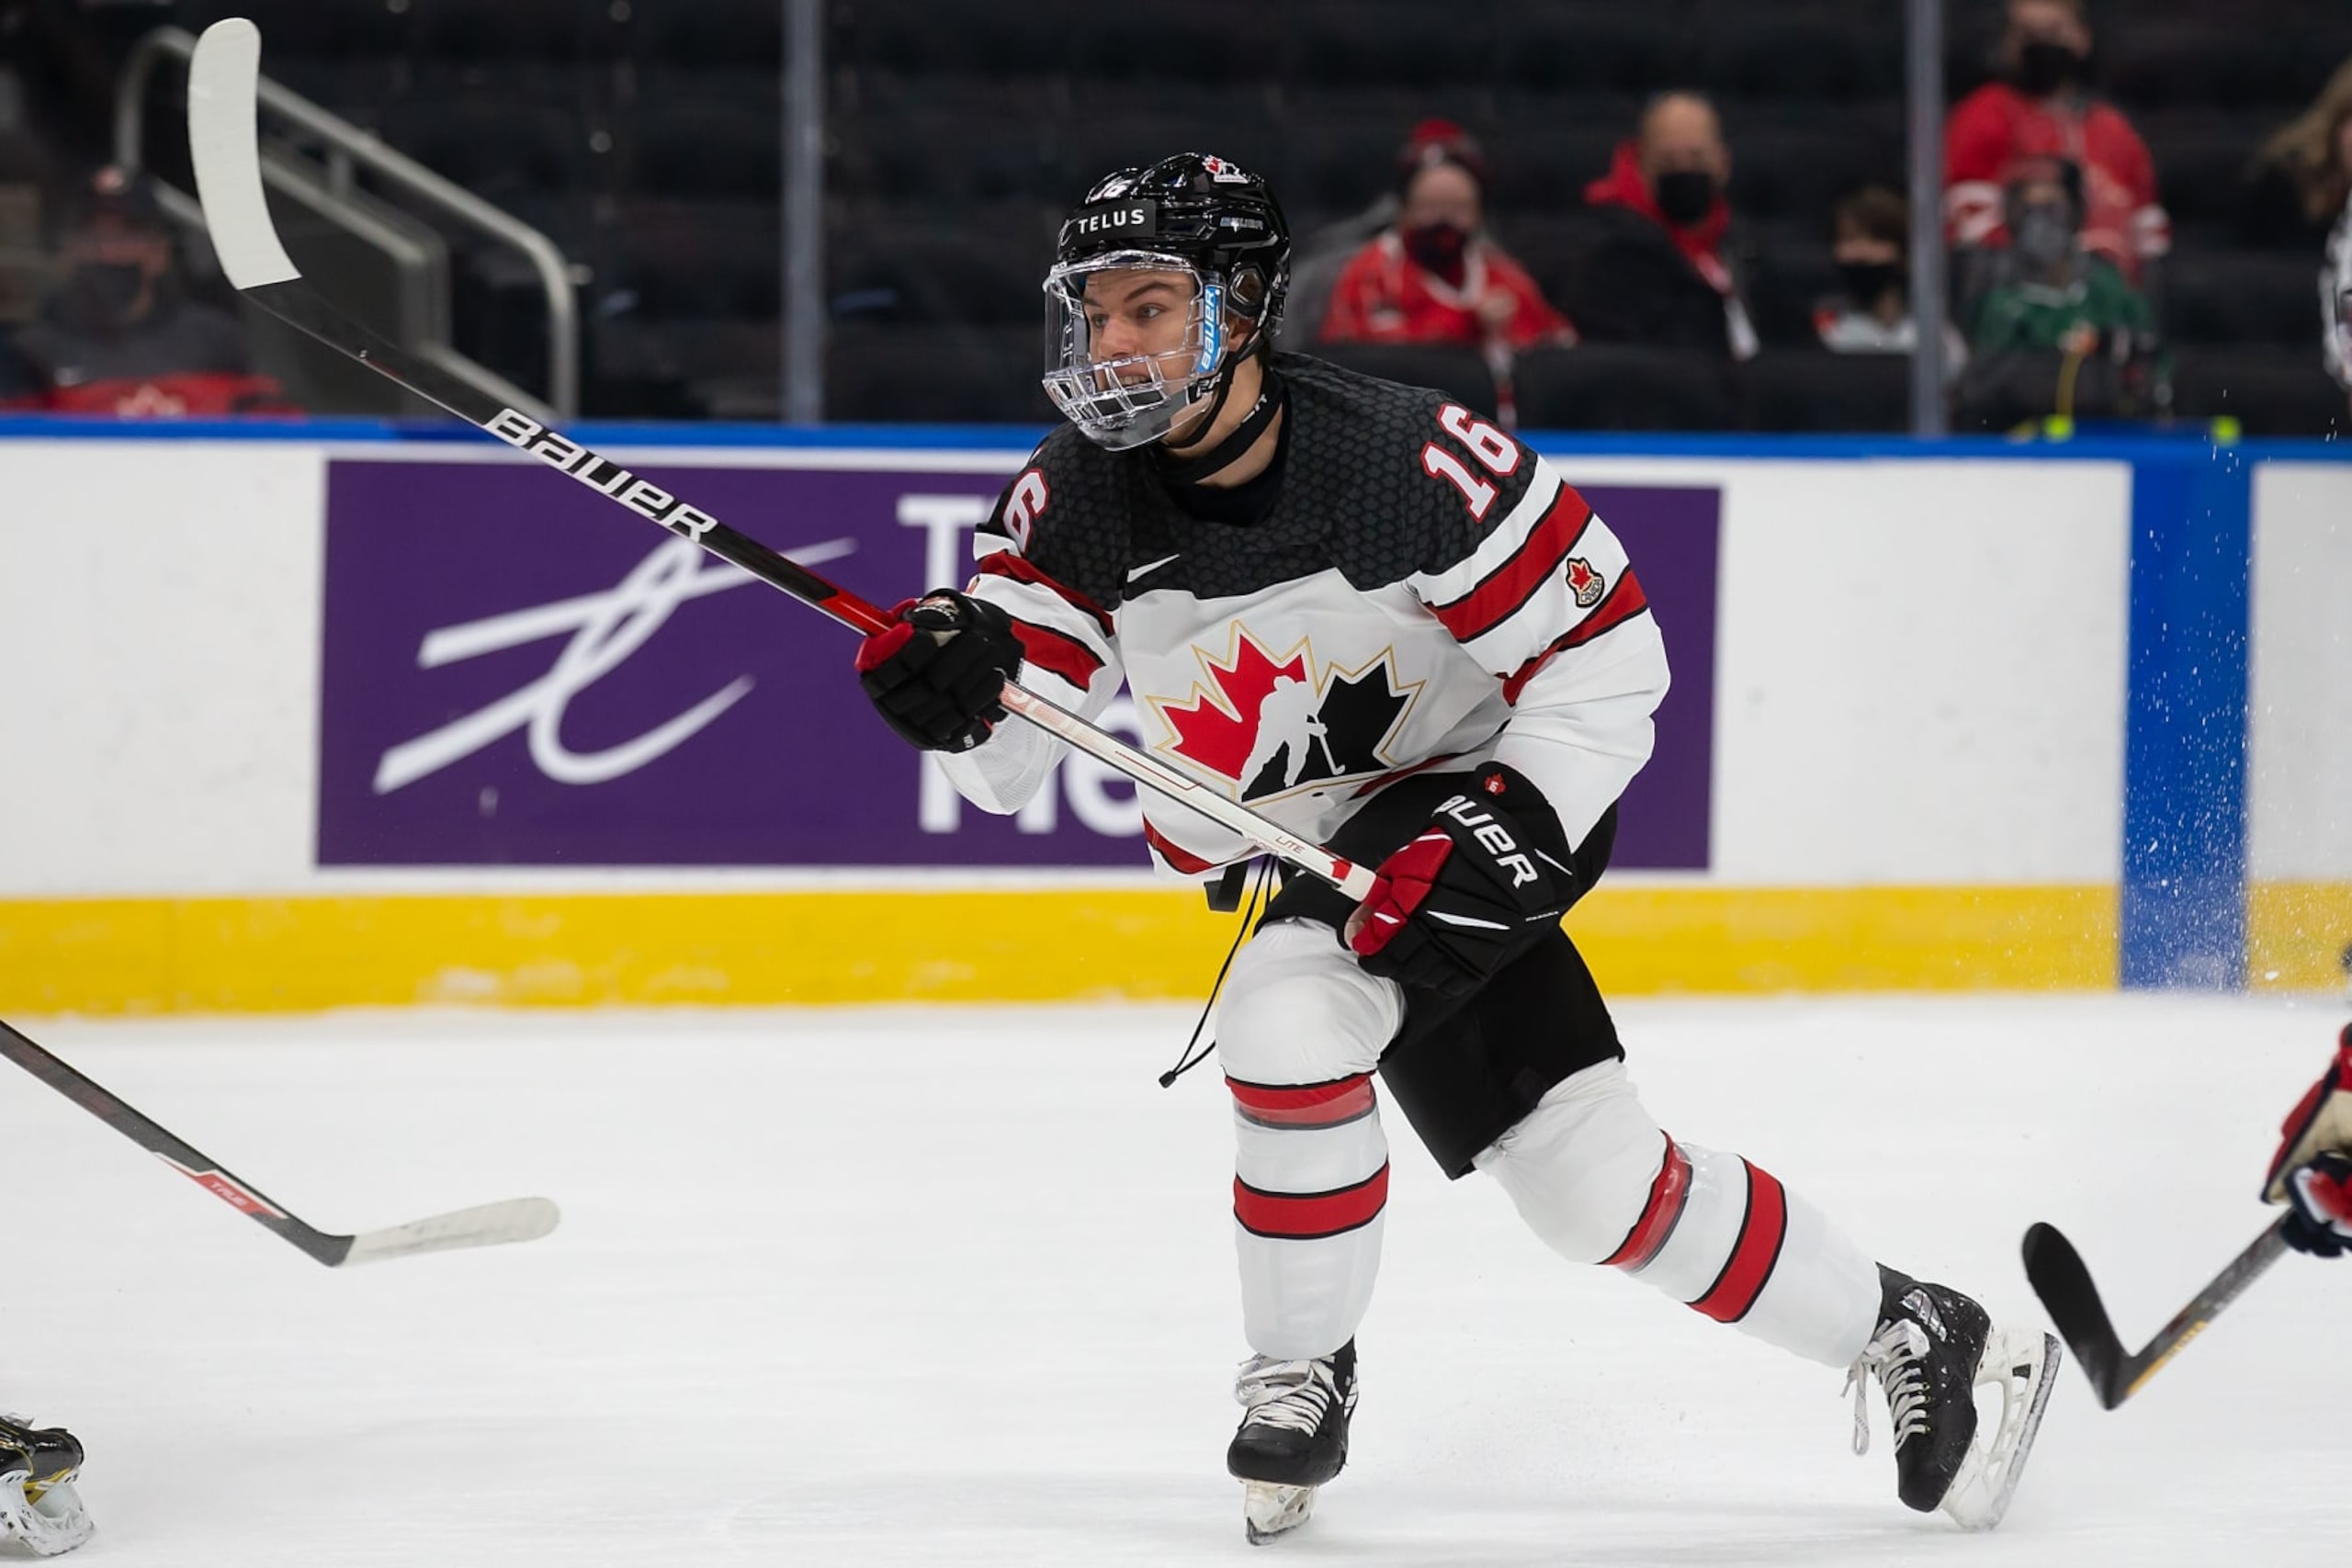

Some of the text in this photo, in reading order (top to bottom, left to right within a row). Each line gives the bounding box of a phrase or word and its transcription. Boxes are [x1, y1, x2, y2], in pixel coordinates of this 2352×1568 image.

[1078, 208, 1146, 234] TELUS
[1420, 402, 1522, 525] 16
[1275, 835, 1306, 854] LITE
